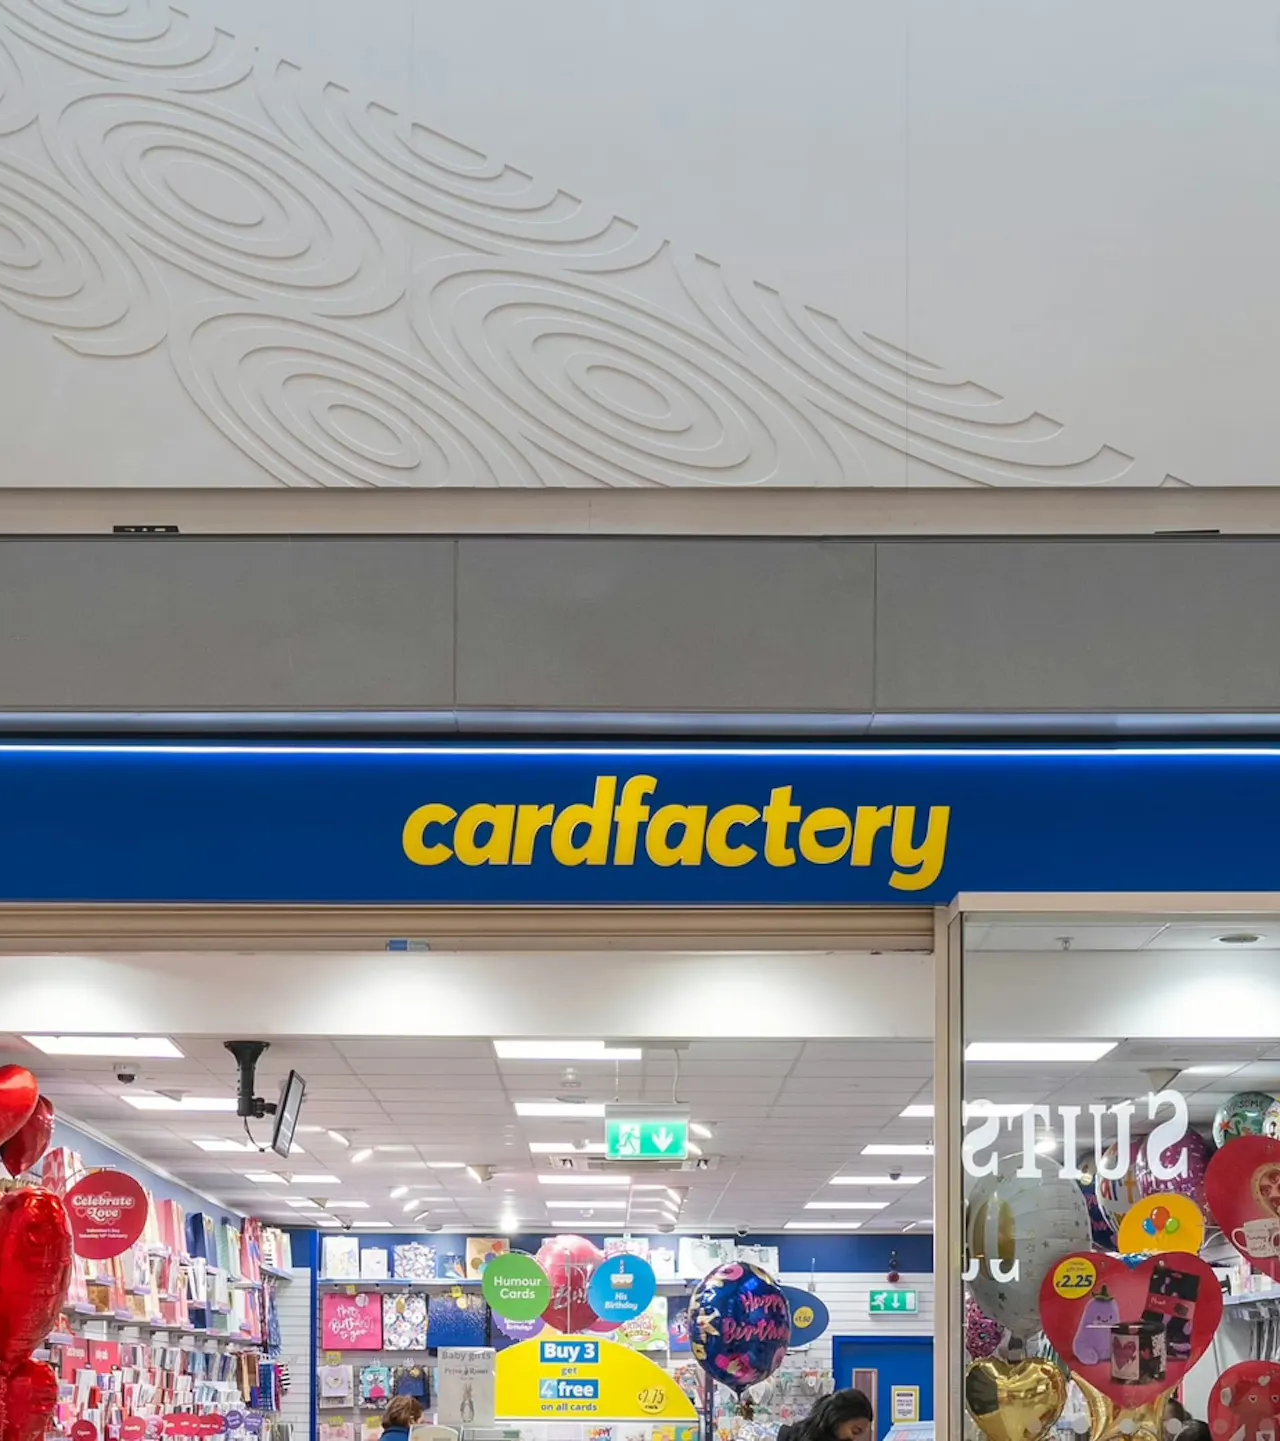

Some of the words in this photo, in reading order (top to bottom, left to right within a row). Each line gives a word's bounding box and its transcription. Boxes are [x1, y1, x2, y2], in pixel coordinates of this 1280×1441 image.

[401, 774, 951, 891] cardfactory
[72, 1193, 133, 1207] Celebrate
[87, 1207, 119, 1222] Love
[494, 1276, 541, 1287] Humour
[500, 1288, 535, 1300] Cards
[615, 1292, 628, 1301] His
[604, 1301, 638, 1311] Birthday
[544, 1343, 579, 1363] Buy
[584, 1343, 595, 1359] 3
[561, 1366, 578, 1375] get
[558, 1381, 595, 1398] free
[556, 1403, 568, 1411] all
[570, 1402, 597, 1411] cards
